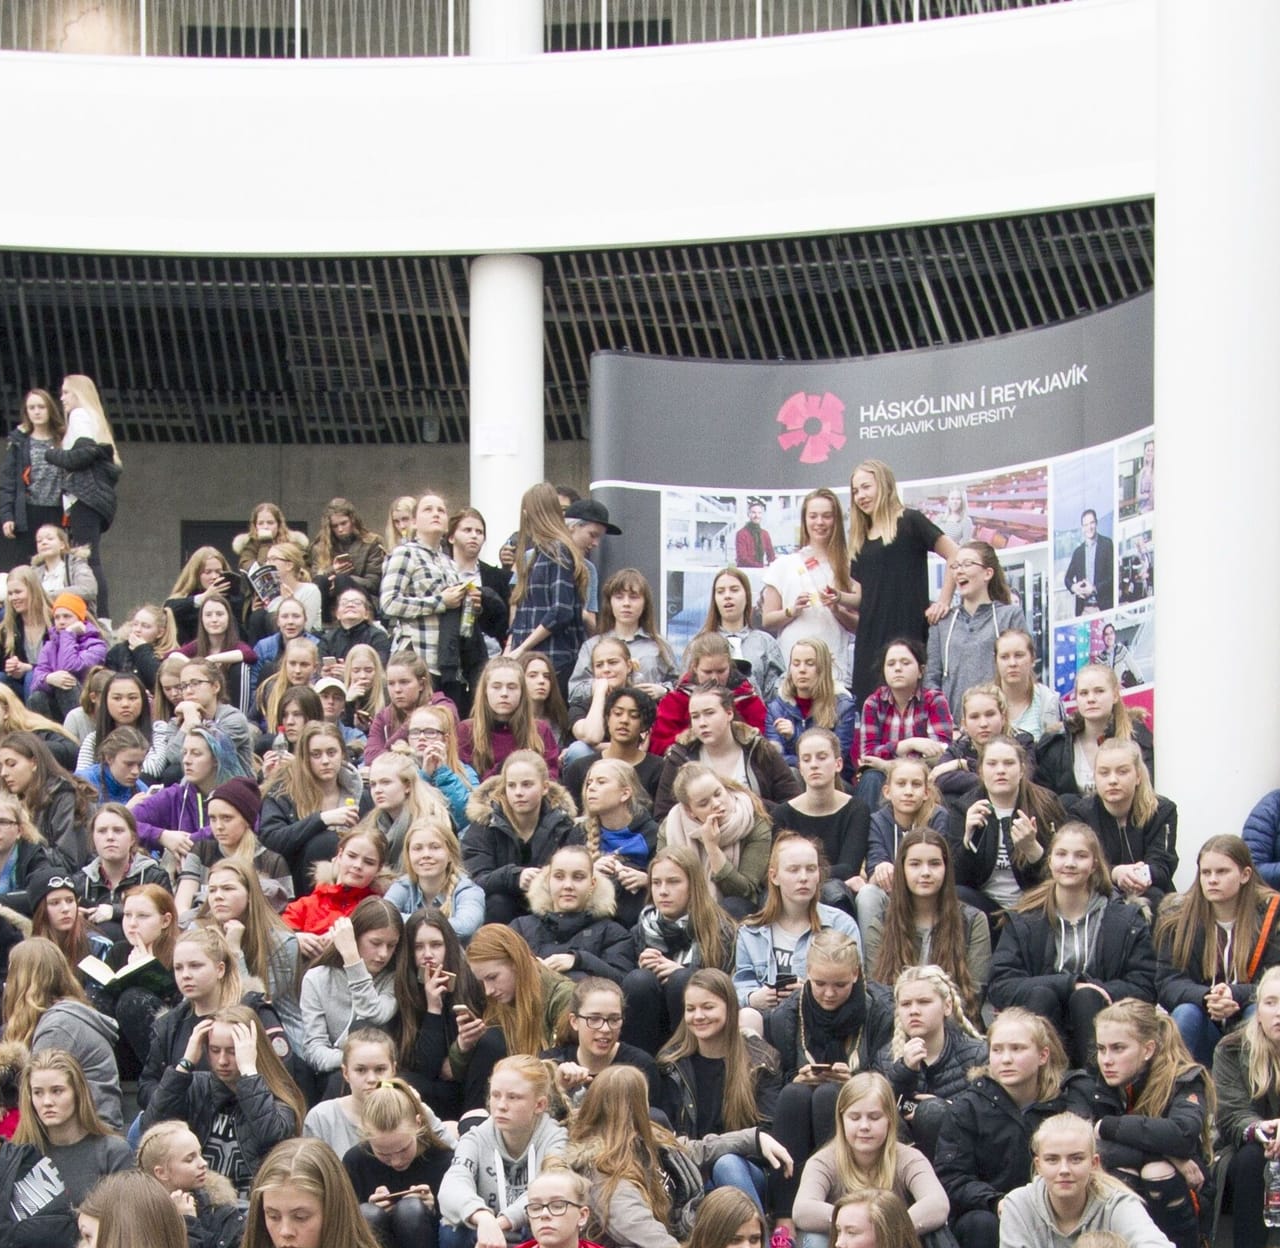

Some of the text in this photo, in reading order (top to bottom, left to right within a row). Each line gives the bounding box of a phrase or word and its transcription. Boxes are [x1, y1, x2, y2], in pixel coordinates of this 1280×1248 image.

[859, 405, 1016, 439] REYKJAVIK UNIVERSITY
[860, 363, 1088, 422] HÁSKÓLINN Í REYKJAVÍK
[10, 1156, 65, 1222] NIKE
